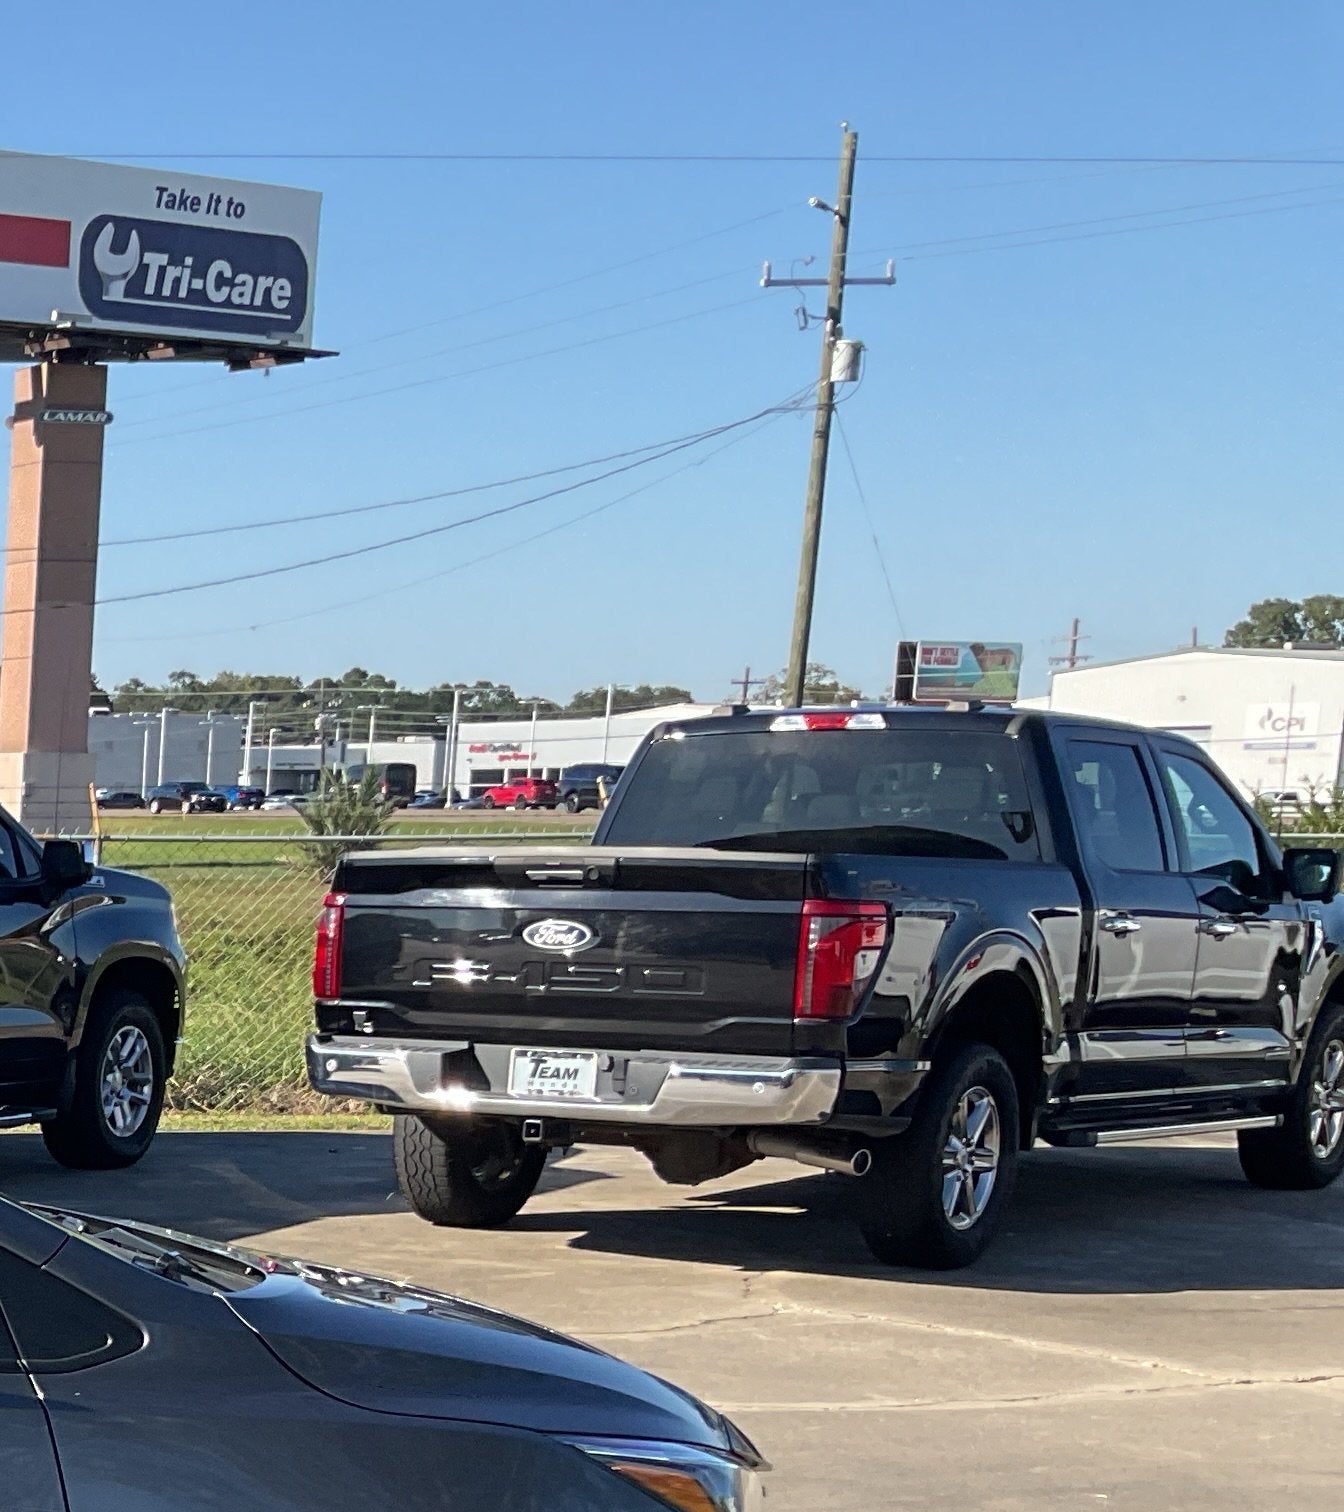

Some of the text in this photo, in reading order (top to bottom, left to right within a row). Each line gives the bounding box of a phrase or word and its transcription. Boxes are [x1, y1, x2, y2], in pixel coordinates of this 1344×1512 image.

[155, 186, 201, 213] Take
[225, 196, 246, 219] to
[142, 252, 292, 310] Tri-Care
[43, 411, 108, 422] LAMAR
[1271, 716, 1306, 732] CPI
[534, 924, 580, 945] Ford
[529, 1058, 580, 1080] TEAM
